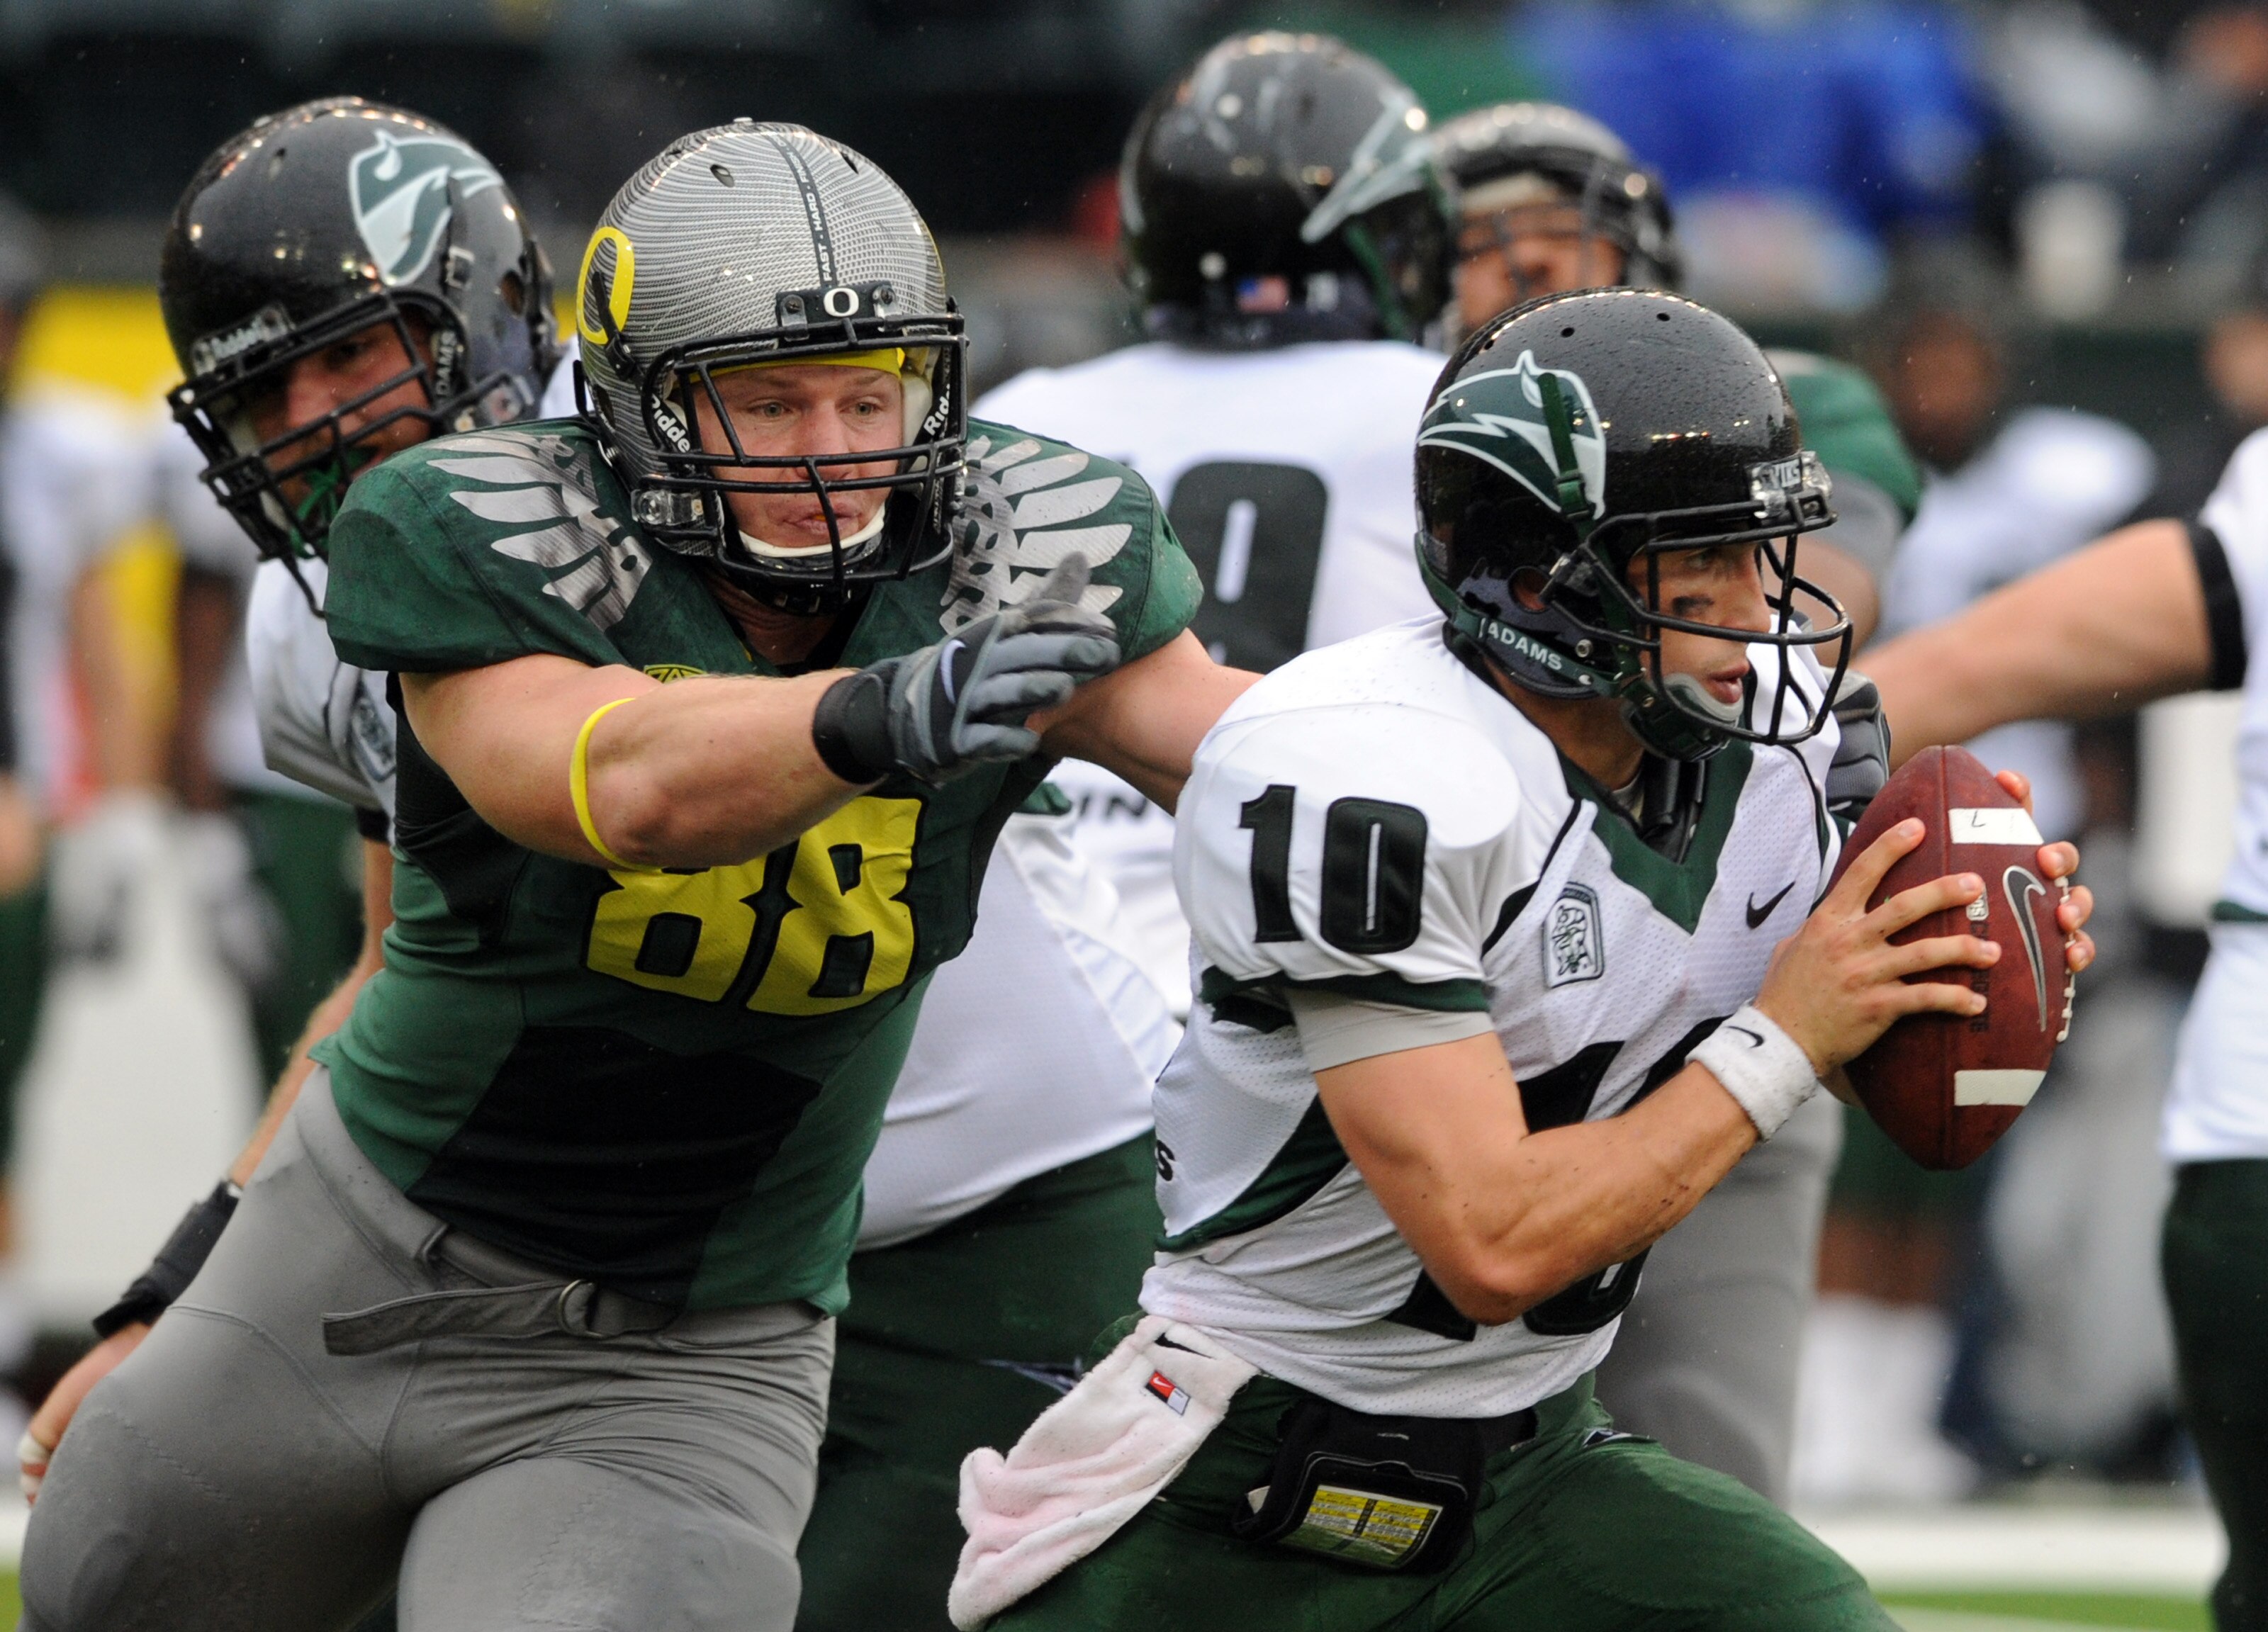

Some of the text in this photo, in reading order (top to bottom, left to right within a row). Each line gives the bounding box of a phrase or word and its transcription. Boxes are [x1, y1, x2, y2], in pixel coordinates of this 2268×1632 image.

[806, 193, 824, 231] HARD
[576, 226, 635, 344] O
[818, 242, 833, 281] FAST
[823, 287, 859, 317] O
[435, 330, 457, 395] DAMS
[1487, 621, 1563, 670] ADAMS
[1238, 784, 1428, 955] 10
[585, 795, 922, 1017] 88
